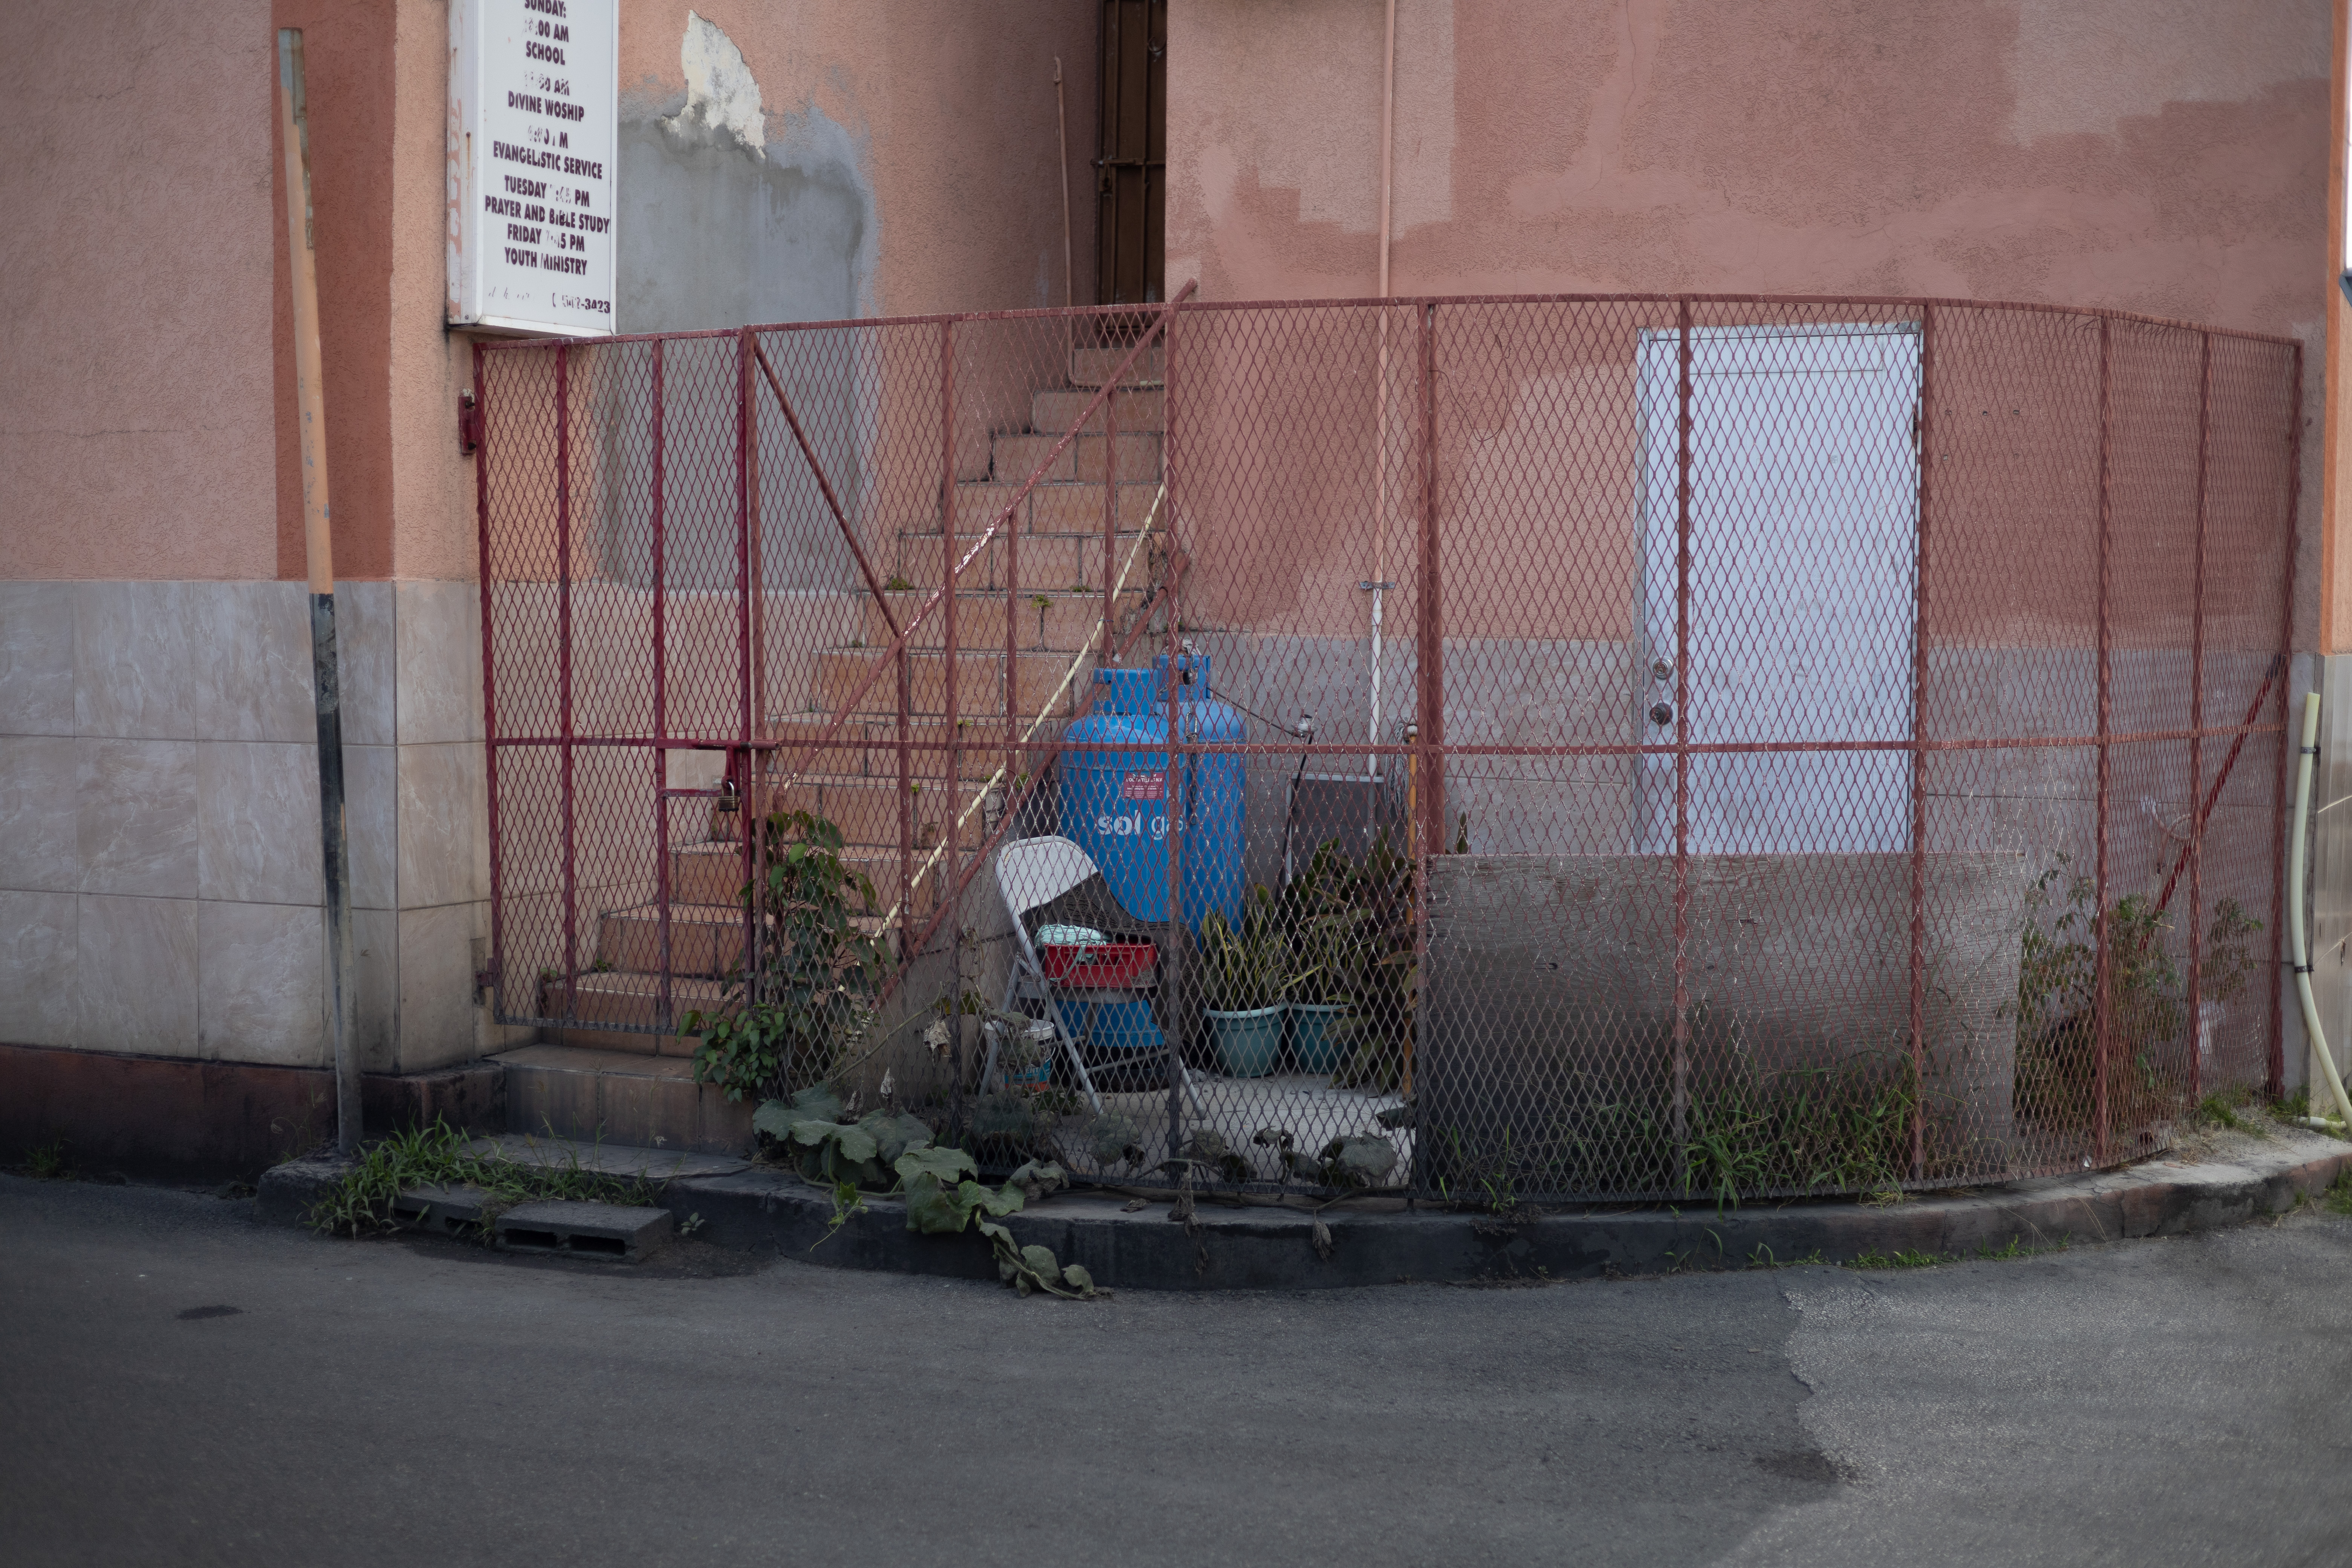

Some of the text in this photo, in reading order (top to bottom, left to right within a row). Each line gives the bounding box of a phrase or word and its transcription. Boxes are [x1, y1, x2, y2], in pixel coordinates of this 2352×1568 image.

[524, 0, 566, 18] SUNDAY:
[553, 23, 569, 43] AM
[526, 40, 565, 65] SCHOOL
[508, 90, 584, 122] DIVINE WOSHIP
[493, 141, 602, 179] EVANGELISTIC SERVICE
[504, 175, 547, 199] TUESDAY
[575, 189, 590, 207] PM
[485, 195, 610, 234] PRAYER AND BIBLE STUDY
[507, 223, 542, 244] FRIDAY
[570, 234, 585, 252] PM
[504, 247, 587, 276] YOUTH MINISTRY
[1098, 810, 1183, 840] sol gs
